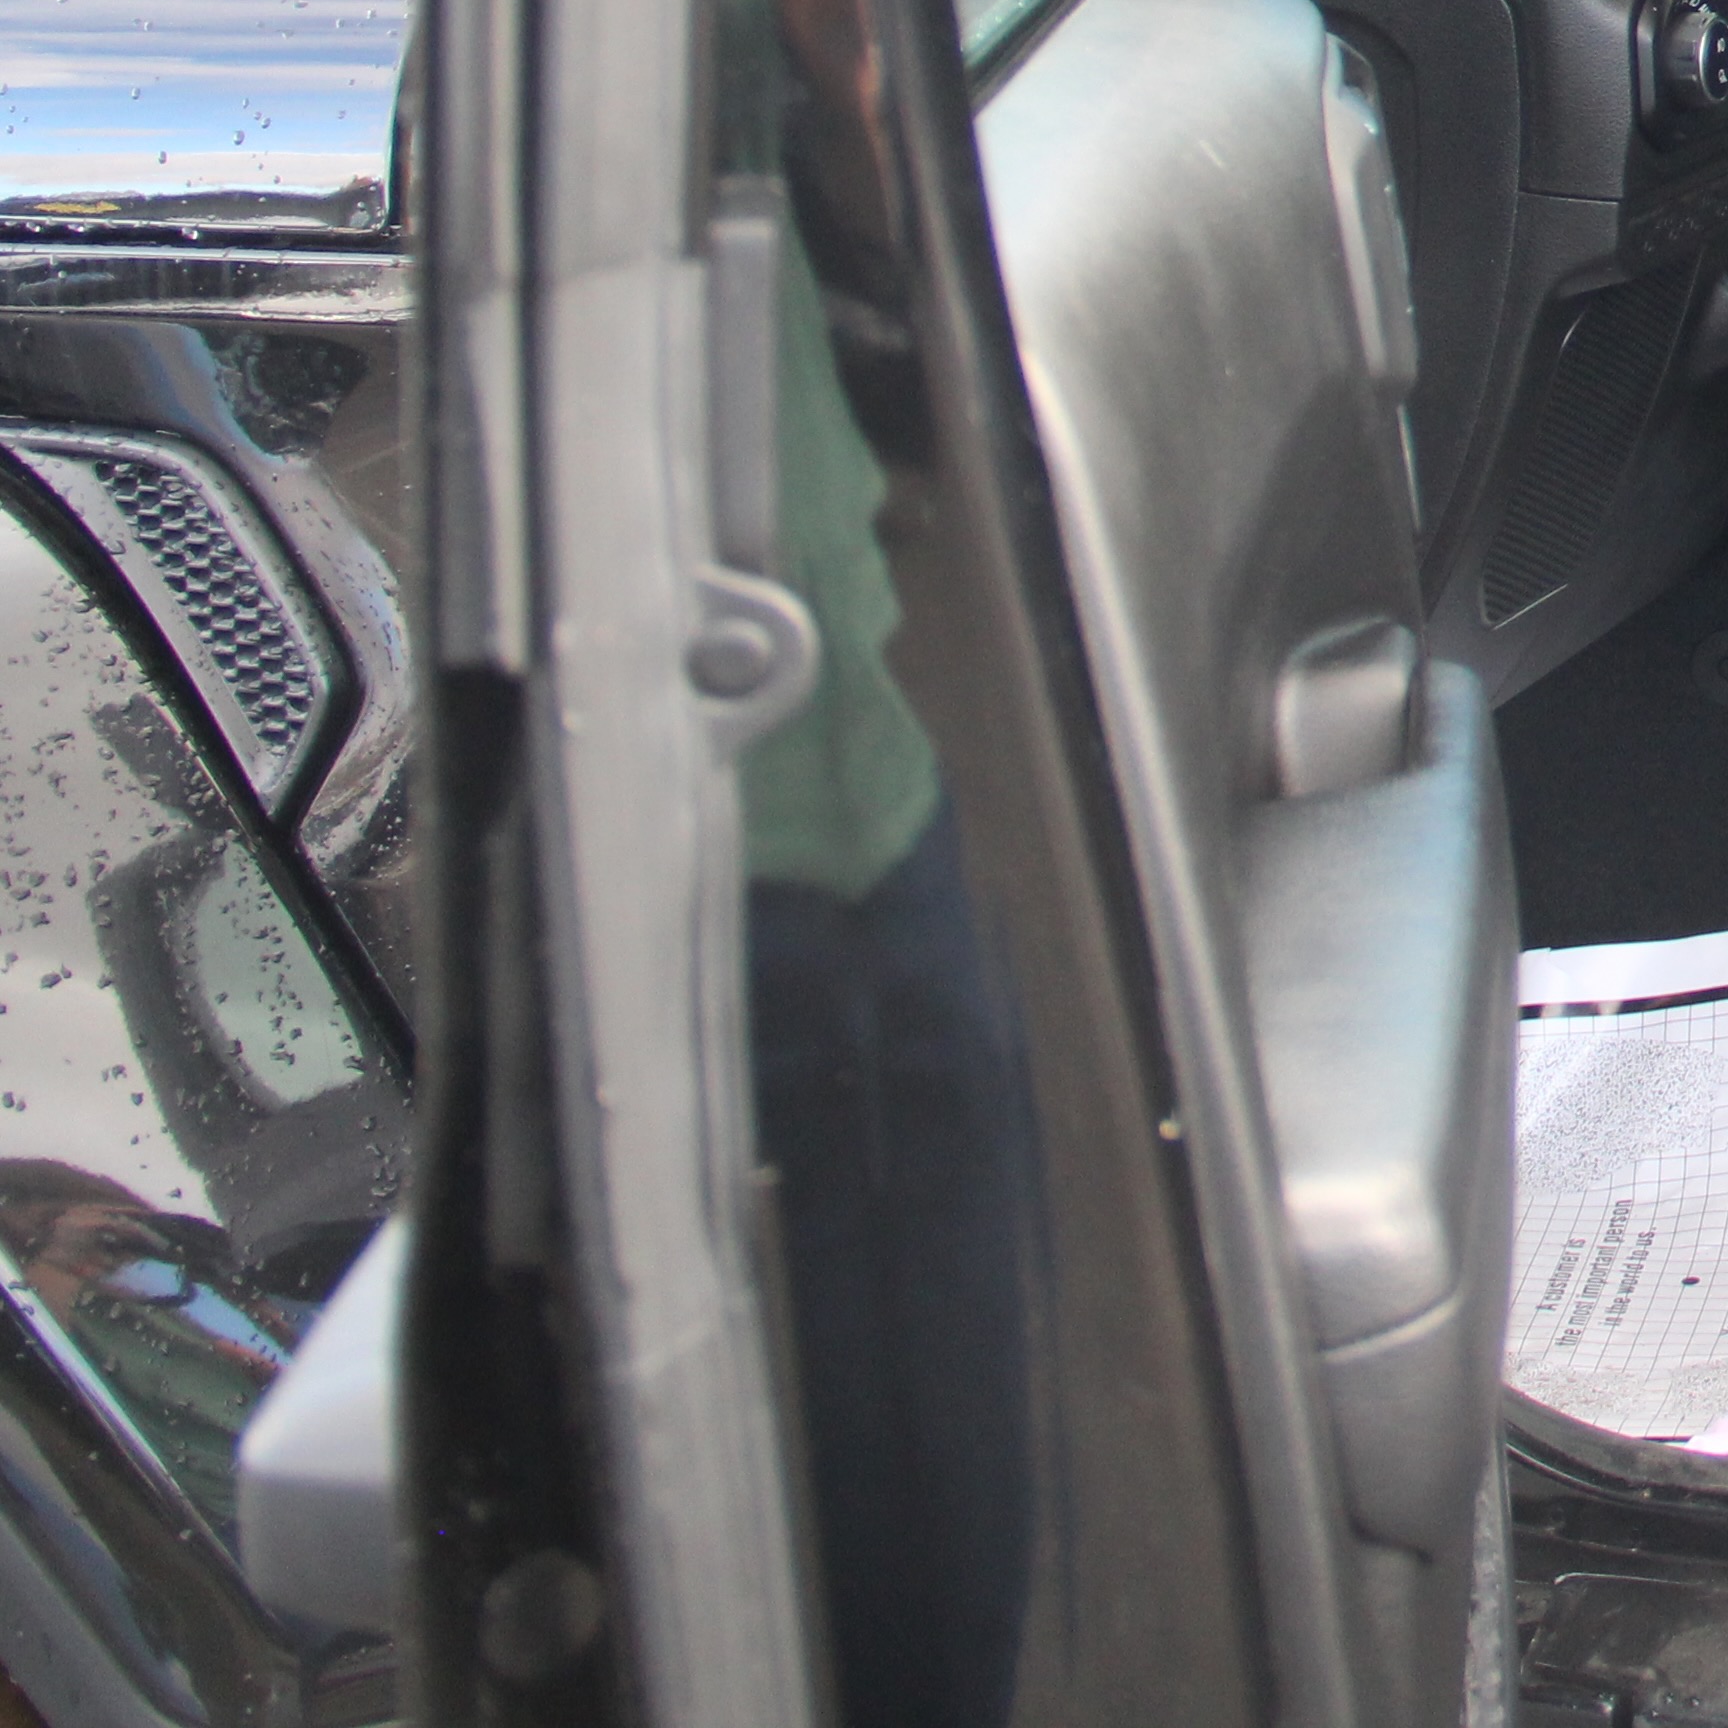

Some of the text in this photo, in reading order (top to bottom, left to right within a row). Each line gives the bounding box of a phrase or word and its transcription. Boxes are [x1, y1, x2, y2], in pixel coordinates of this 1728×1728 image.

[1536, 1238, 1586, 1311] A customer is
[1555, 1199, 1633, 1346] the most important person
[1599, 1227, 1657, 1326] in the world to us.
